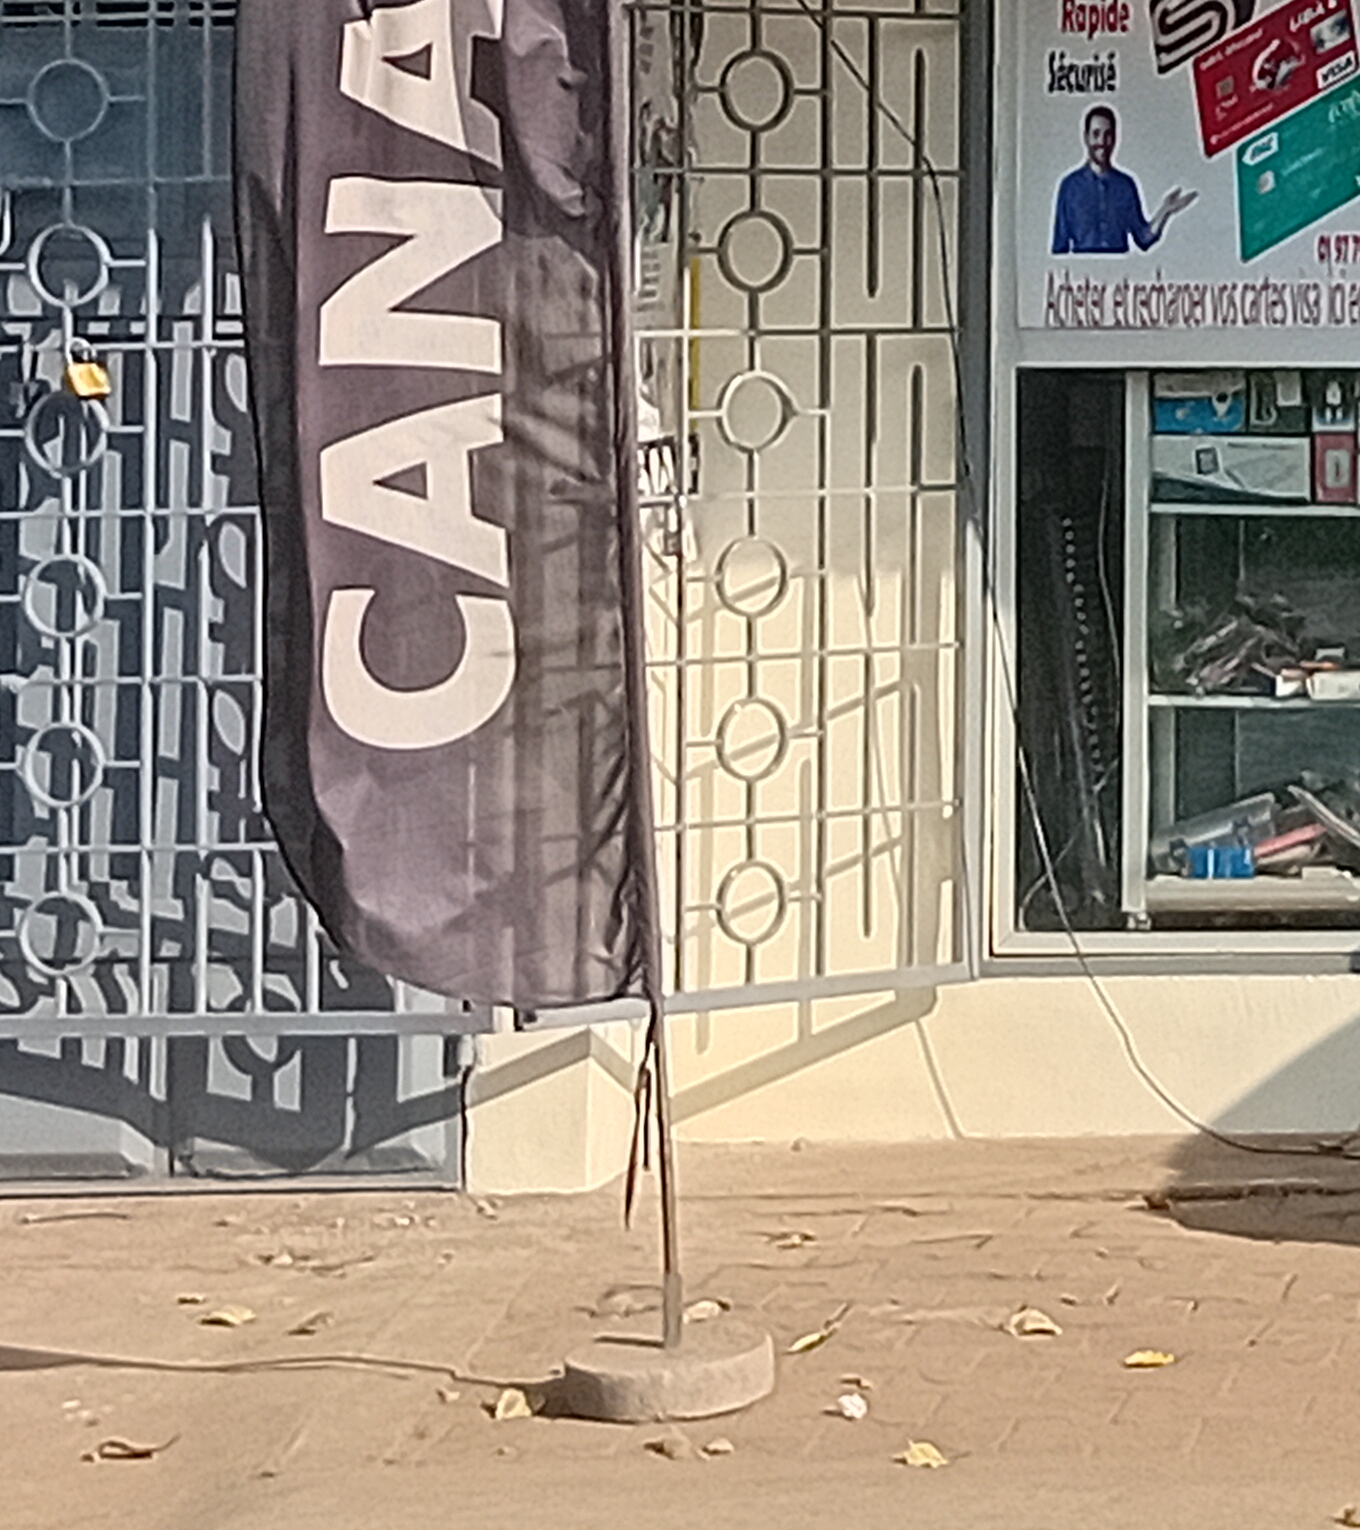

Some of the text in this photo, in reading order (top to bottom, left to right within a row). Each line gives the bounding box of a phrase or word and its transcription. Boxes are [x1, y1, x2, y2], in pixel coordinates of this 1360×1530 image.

[1048, 50, 1117, 93] Sécurisé
[1047, 268, 1107, 327] Acheter
[1241, 276, 1287, 326] cartes
